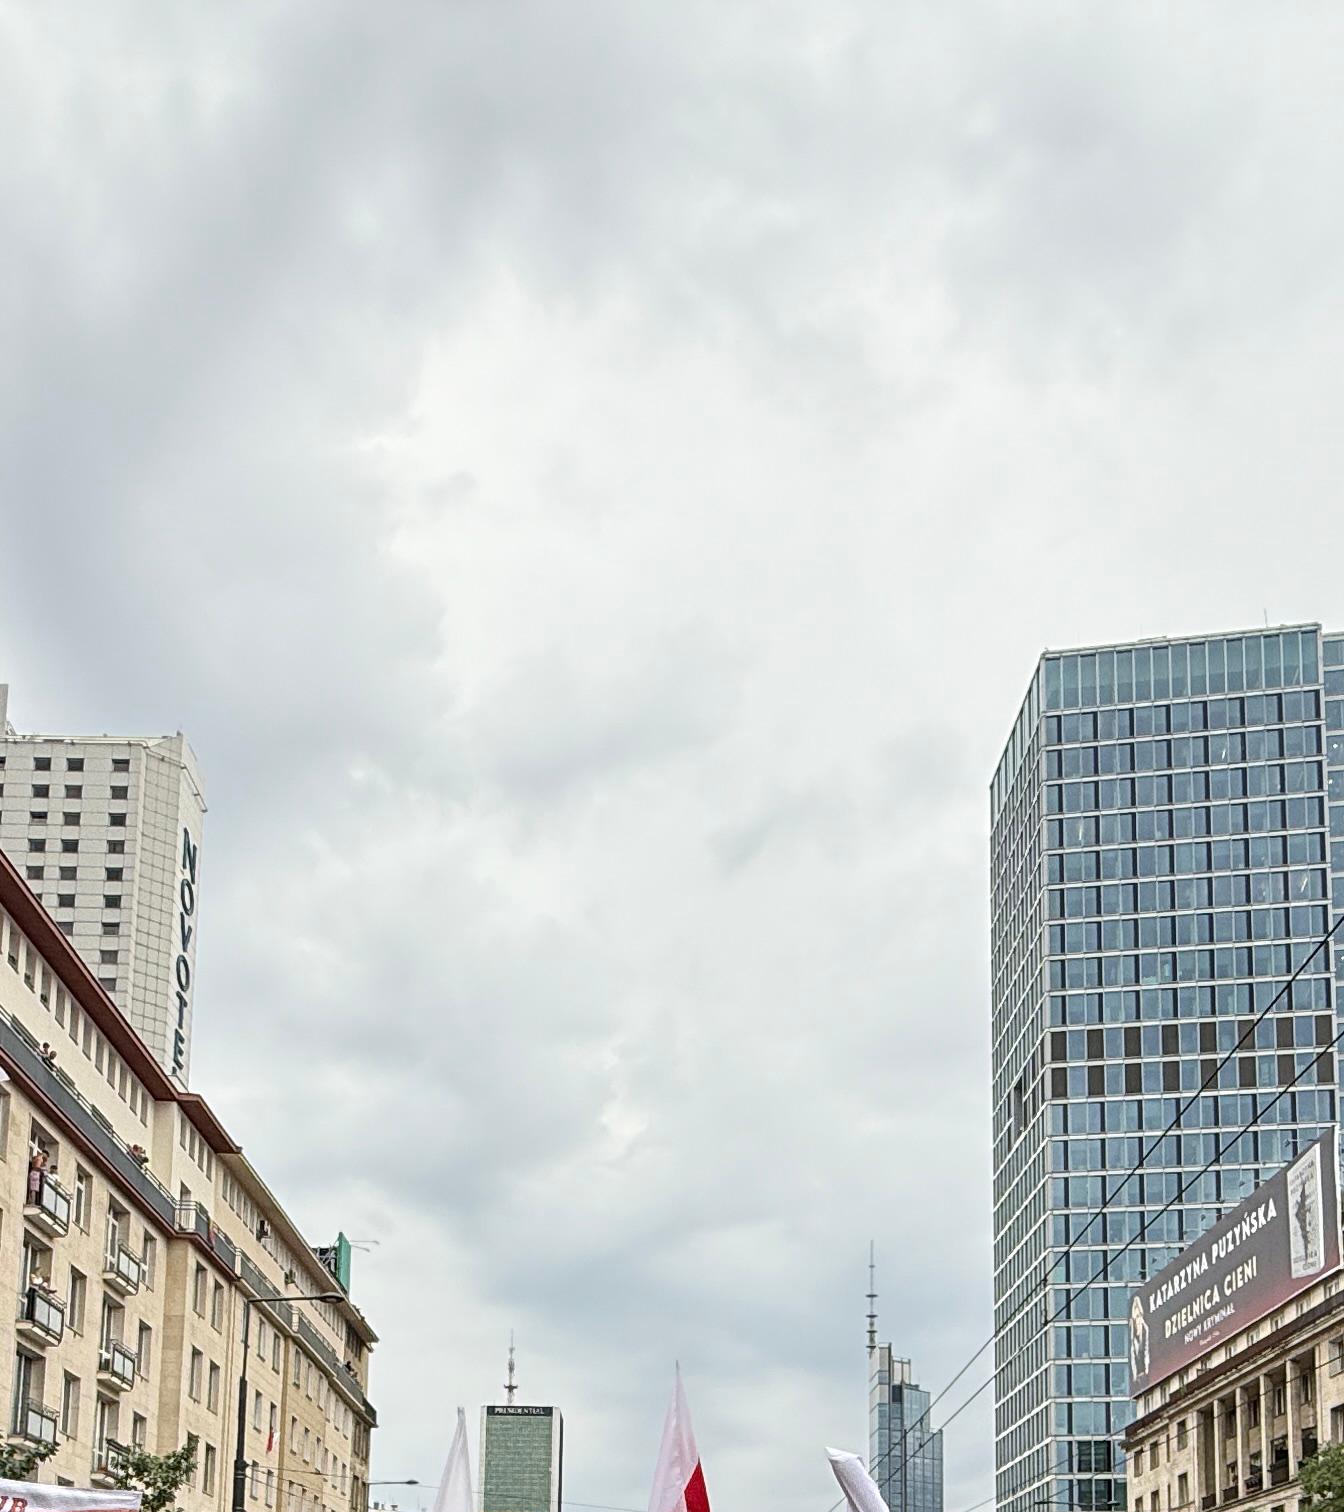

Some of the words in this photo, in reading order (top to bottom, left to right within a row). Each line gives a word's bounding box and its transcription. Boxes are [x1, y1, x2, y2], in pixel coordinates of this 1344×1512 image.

[1149, 1252, 1208, 1314] KATARZYNA
[1211, 1197, 1277, 1265] PUZYŃSKA
[1164, 1290, 1220, 1339] DZIELNICA
[1223, 1255, 1257, 1297] CIENI
